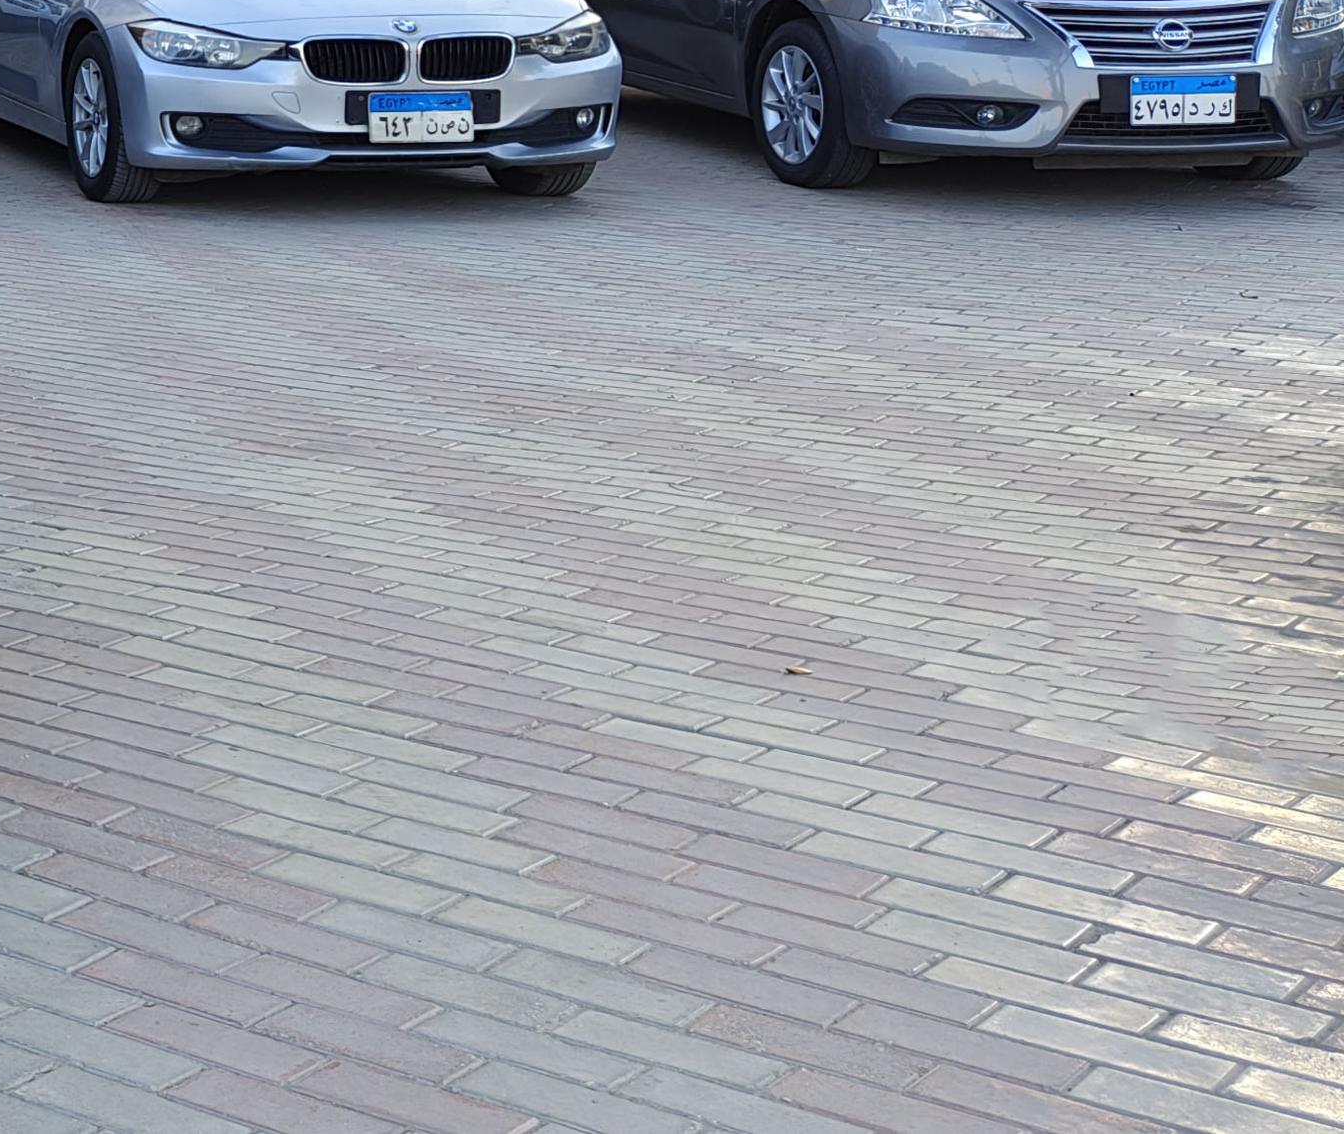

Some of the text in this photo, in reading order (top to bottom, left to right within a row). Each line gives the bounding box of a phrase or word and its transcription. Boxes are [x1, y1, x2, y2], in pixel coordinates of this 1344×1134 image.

[1161, 30, 1189, 39] NISSAN
[1141, 80, 1176, 91] EGYPT
[1197, 79, 1227, 90] مصر
[1134, 99, 1181, 121] ٤٧٩٥
[379, 116, 412, 137] ٦٤٣
